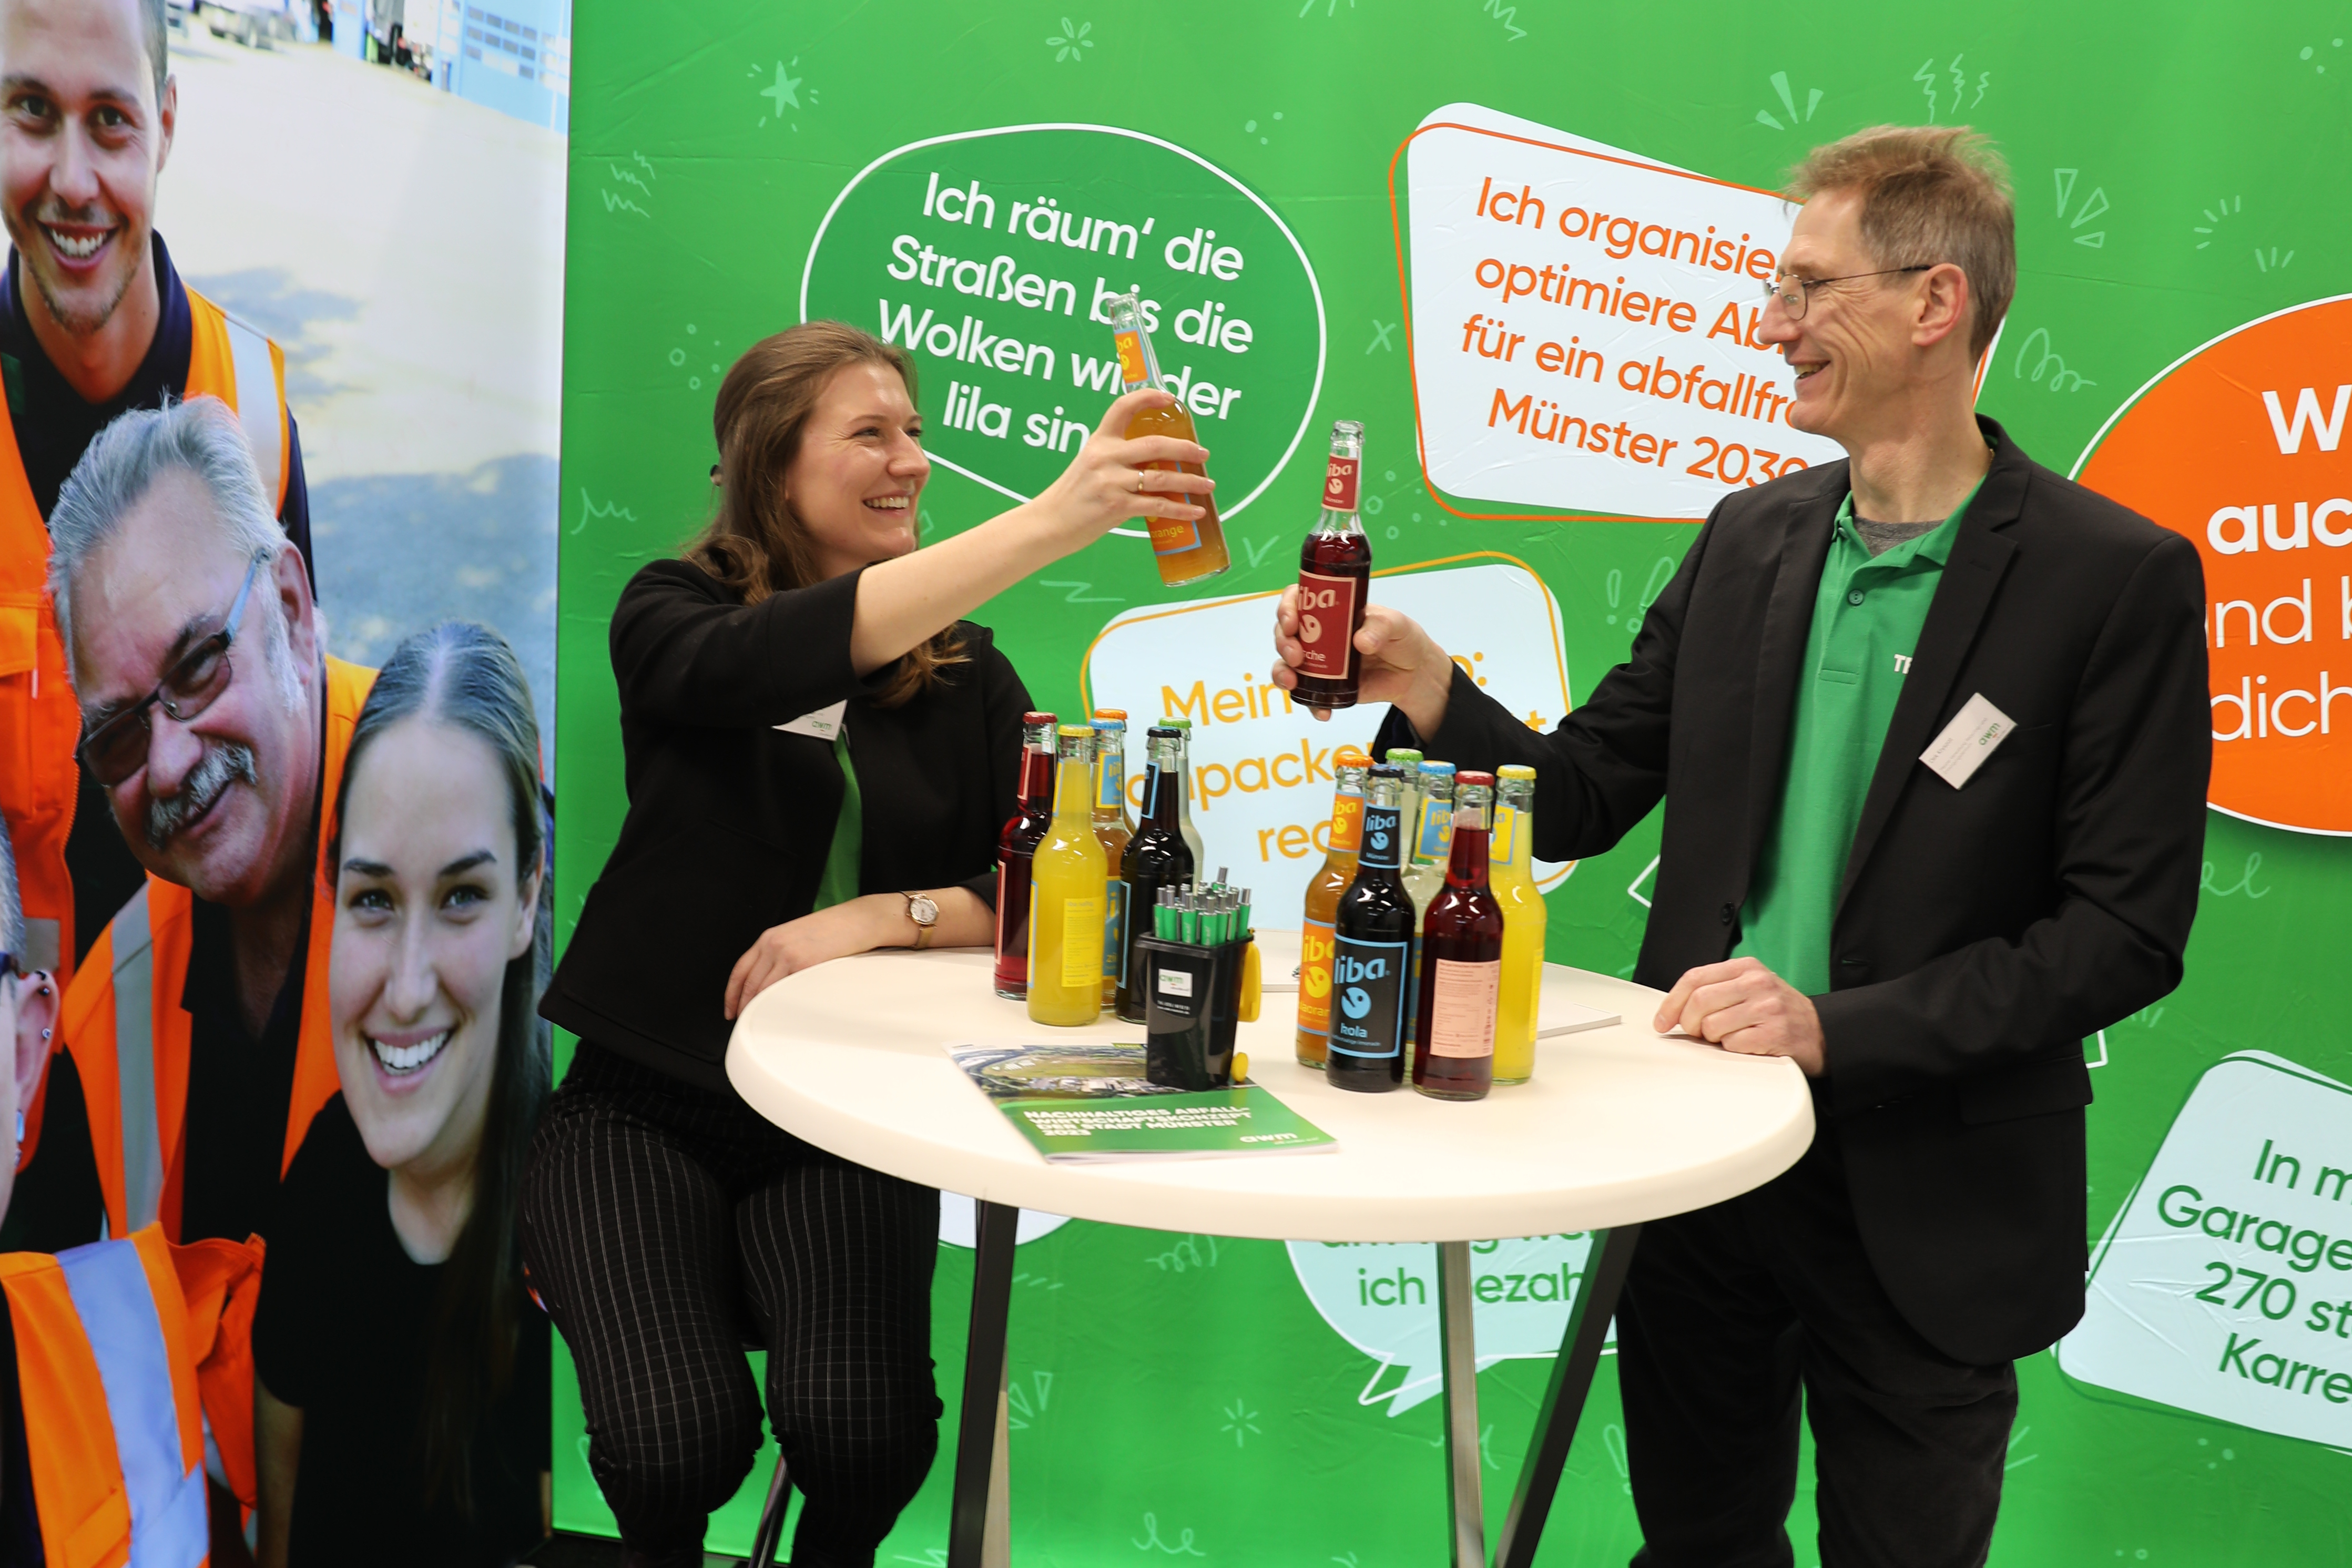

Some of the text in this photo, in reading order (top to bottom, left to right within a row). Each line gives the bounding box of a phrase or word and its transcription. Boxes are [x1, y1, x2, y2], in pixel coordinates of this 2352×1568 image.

[922, 172, 995, 229] Ich
[1165, 227, 1244, 281] die
[1476, 177, 1783, 283] Ich organisie
[887, 235, 1076, 316] Straßen
[1174, 300, 1254, 354] die
[1475, 258, 1784, 355] optimiere Ab
[879, 298, 1241, 420] Wolken wider
[1462, 313, 1525, 363] für
[1535, 336, 1604, 382] ein
[942, 381, 1092, 454] lila sin
[1488, 388, 1677, 469] Münster
[2205, 578, 2313, 648] nd
[2210, 670, 2352, 741] dich
[1366, 814, 1397, 832] liba
[1333, 955, 1386, 984] liba
[1340, 1022, 1368, 1038] kola
[1239, 1132, 1298, 1143] awm
[2253, 1139, 2301, 1189] In
[1358, 1262, 1585, 1306] ich ezah
[2195, 1262, 2296, 1320] 270
